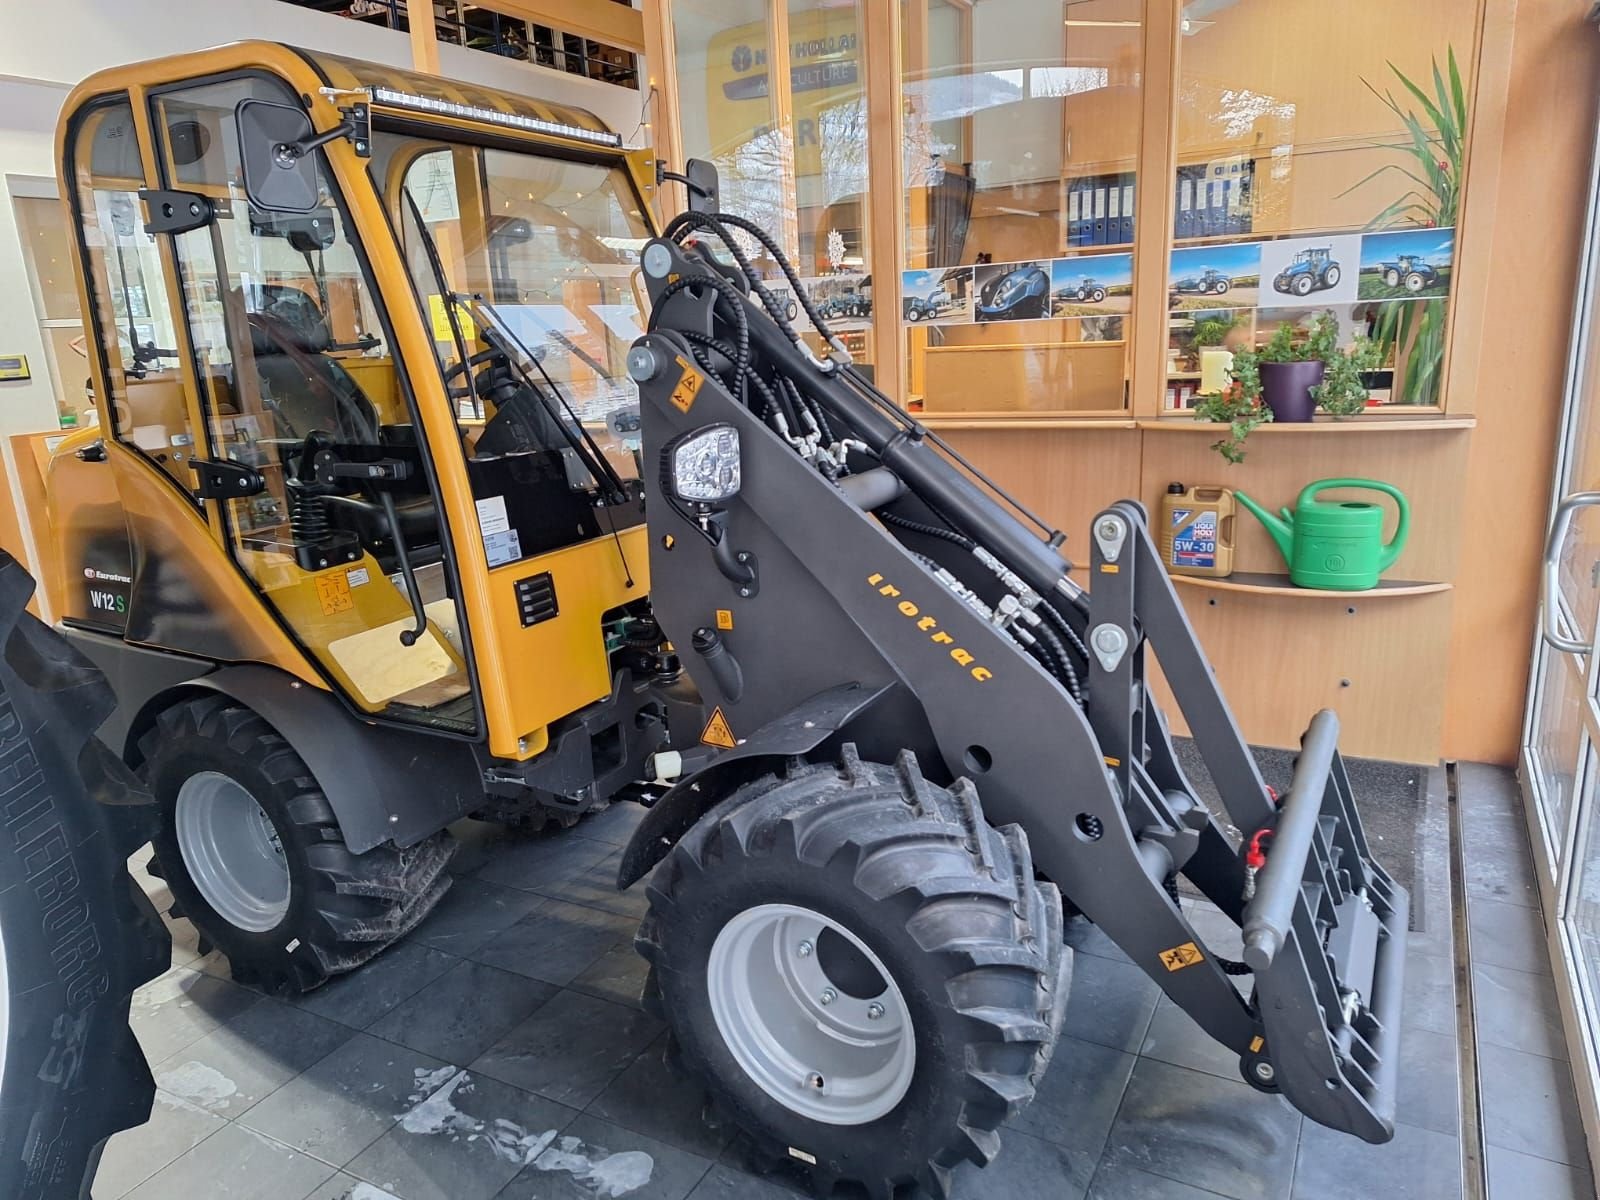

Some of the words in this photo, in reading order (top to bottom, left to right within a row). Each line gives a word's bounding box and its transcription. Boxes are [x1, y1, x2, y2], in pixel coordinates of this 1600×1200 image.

[1174, 540, 1214, 552] 5W-30
[97, 571, 131, 582] Eurotrac
[91, 591, 115, 611] W12
